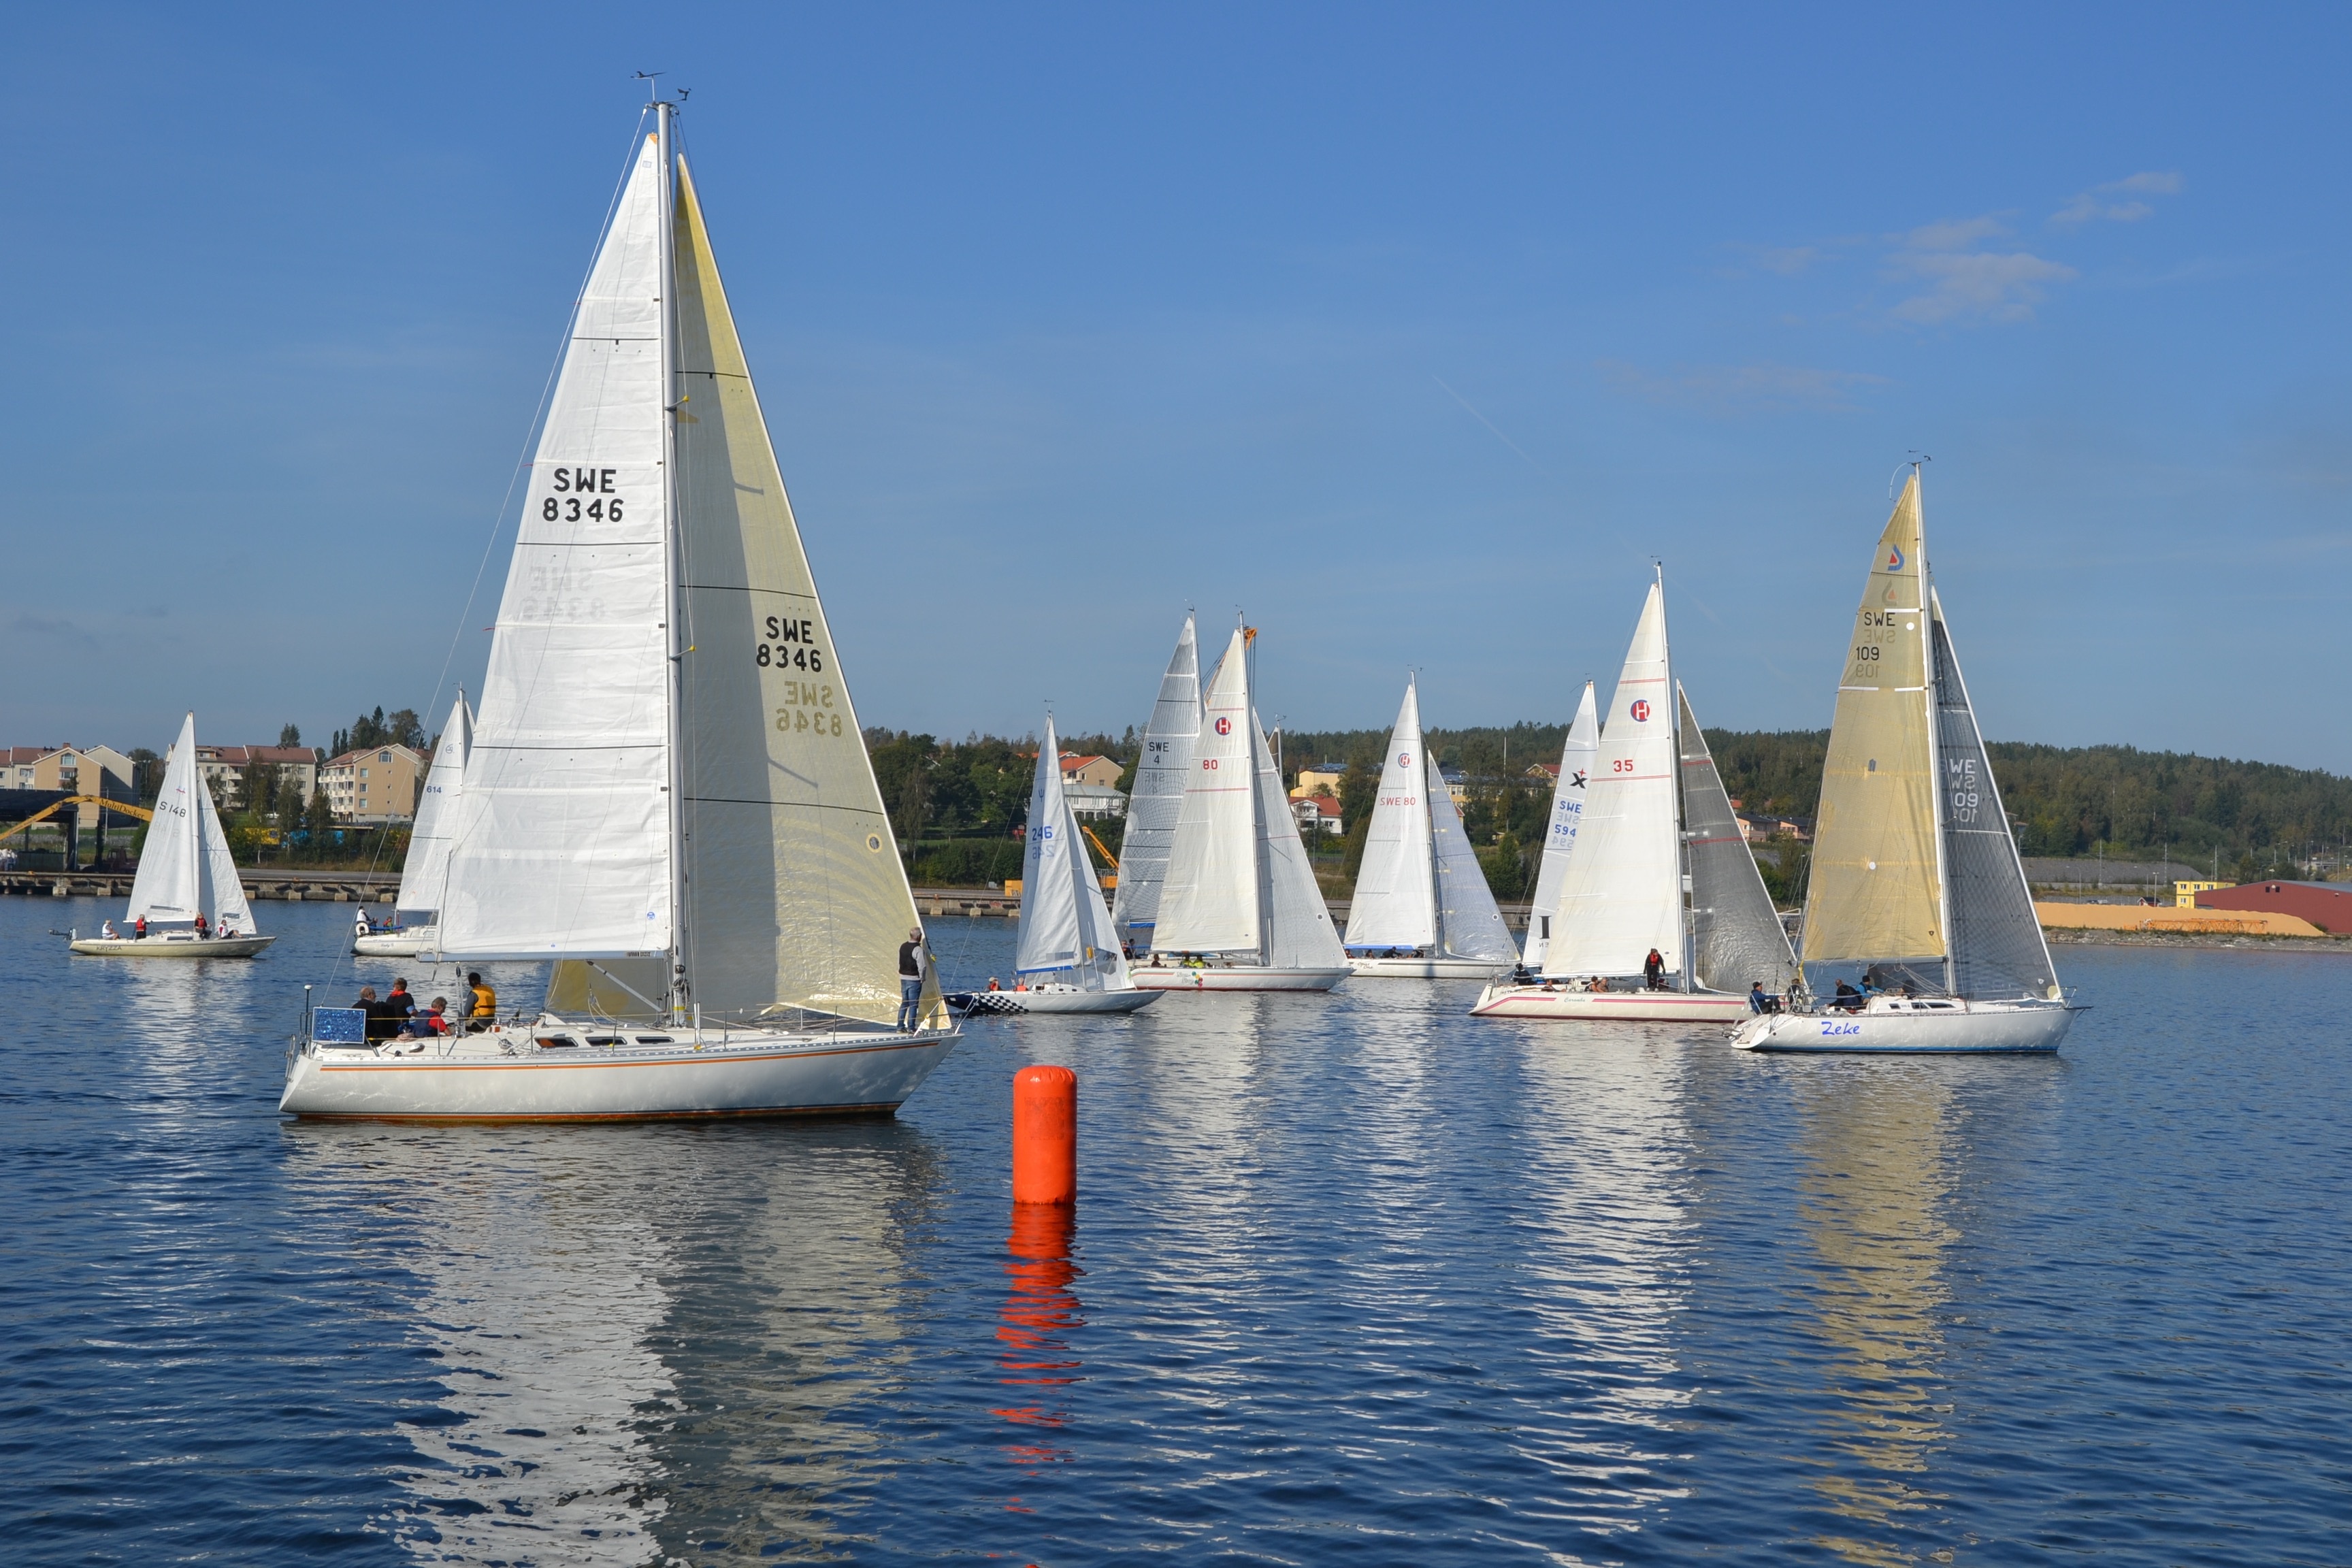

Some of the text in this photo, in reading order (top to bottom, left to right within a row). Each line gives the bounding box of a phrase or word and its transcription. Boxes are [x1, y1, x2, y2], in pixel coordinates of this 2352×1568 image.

[553, 468, 617, 493] SWE
[542, 497, 624, 523] 8346
[1864, 612, 1895, 626] SWE
[766, 616, 814, 644] SWE
[756, 643, 822, 672] 8346
[1856, 646, 1879, 661] 109
[1149, 741, 1169, 752] SWE
[1154, 755, 1160, 765] 4
[1203, 760, 1218, 770] 80
[1613, 760, 1633, 772] 35
[99, 798, 145, 819] MultiDocker
[1380, 797, 1416, 806] SWE 80
[1559, 800, 1582, 814] SWE
[159, 801, 186, 817] S 148
[1032, 826, 1053, 841] 246
[1554, 824, 1576, 837] 594
[1821, 1022, 1860, 1035] Zeke
